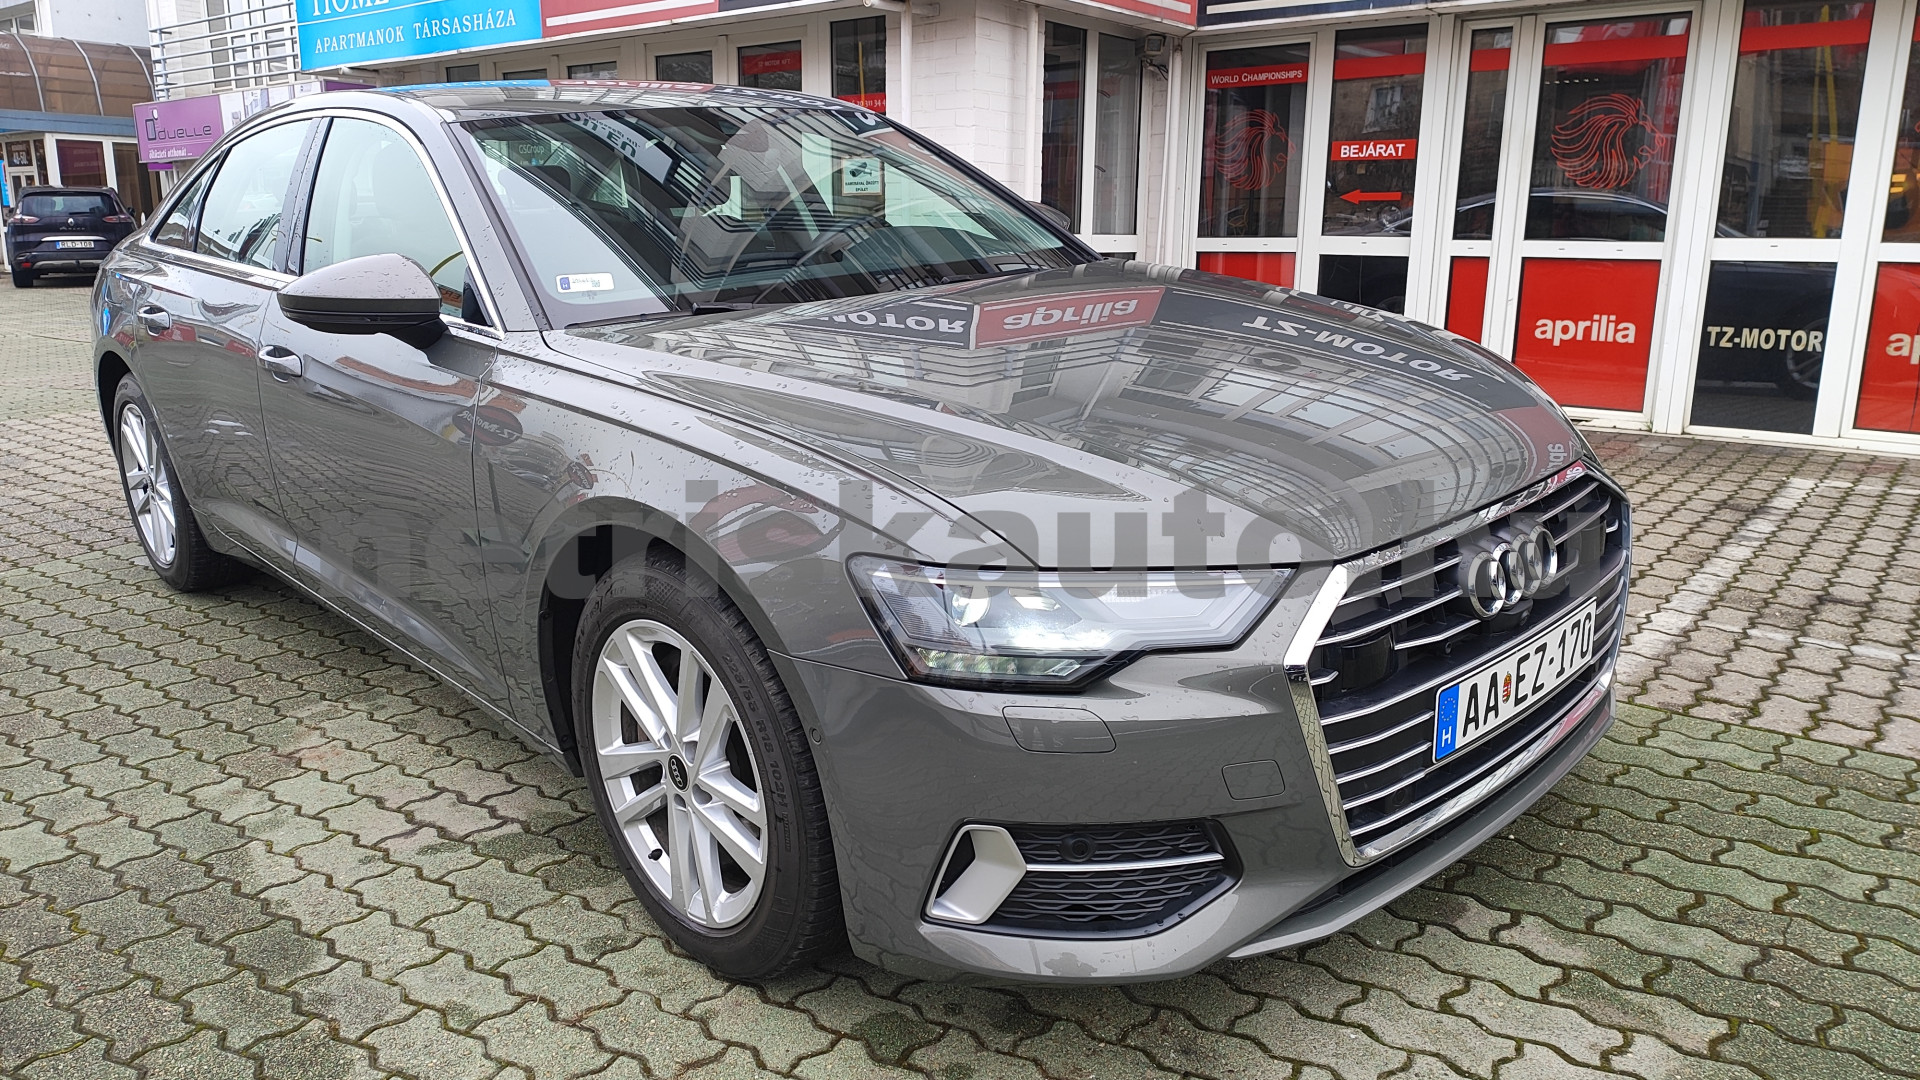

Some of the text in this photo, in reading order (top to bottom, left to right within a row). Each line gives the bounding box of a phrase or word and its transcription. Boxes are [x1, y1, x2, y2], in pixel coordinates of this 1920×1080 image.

[314, 8, 517, 54] APARTMANOK TÁRSASHÁZA
[1340, 141, 1405, 158] BEJÁRAT
[1534, 314, 1636, 347] aprilia
[1707, 326, 1824, 353] TZ-MOTOR
[1462, 611, 1592, 738] AA EZ-170
[1441, 726, 1452, 748] H
